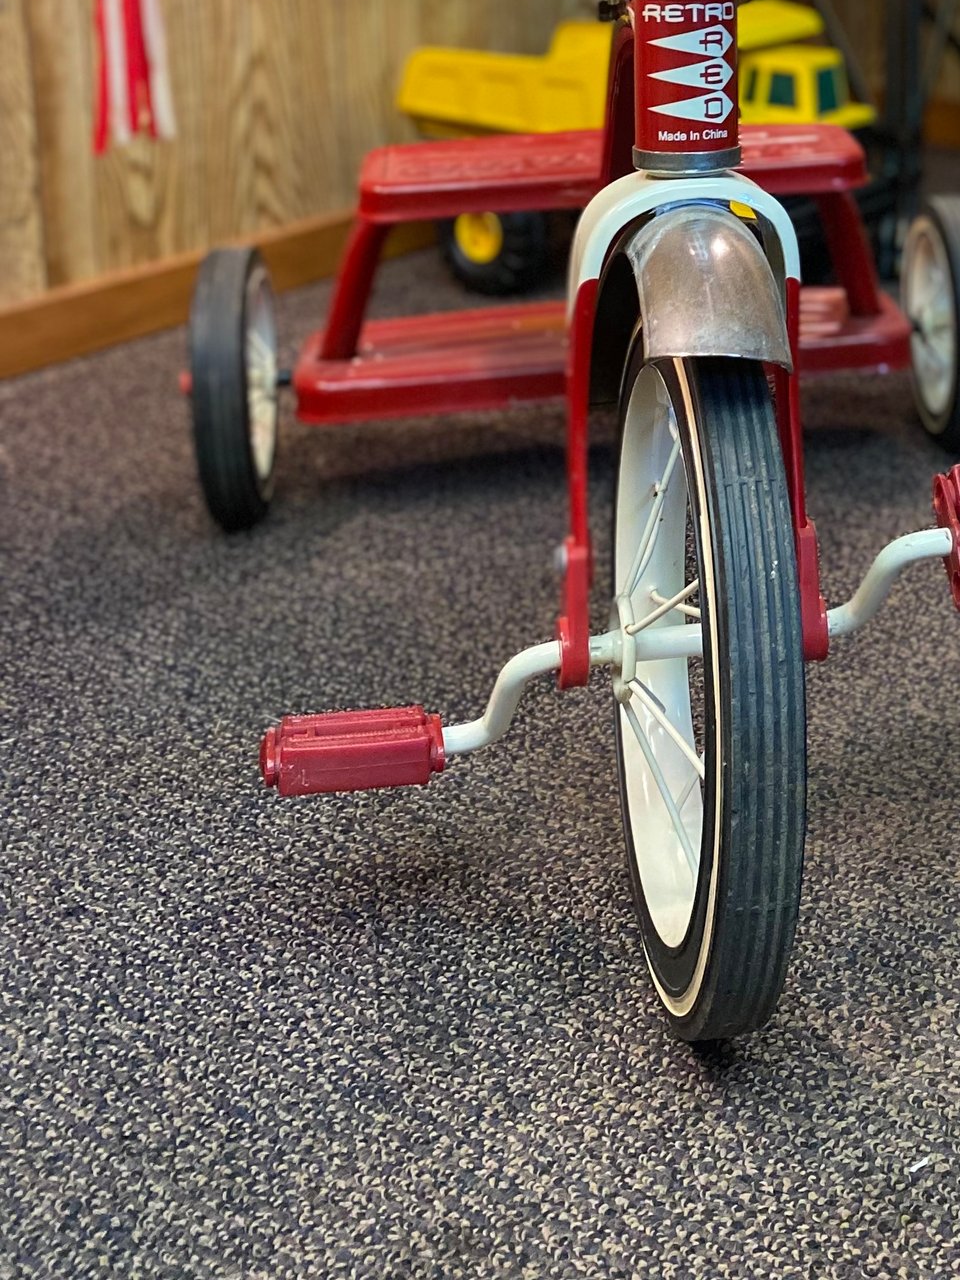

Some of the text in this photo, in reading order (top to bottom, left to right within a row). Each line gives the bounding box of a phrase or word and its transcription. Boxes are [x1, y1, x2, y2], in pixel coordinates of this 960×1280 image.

[642, 1, 735, 23] RETRO
[658, 128, 728, 142] Made In China
